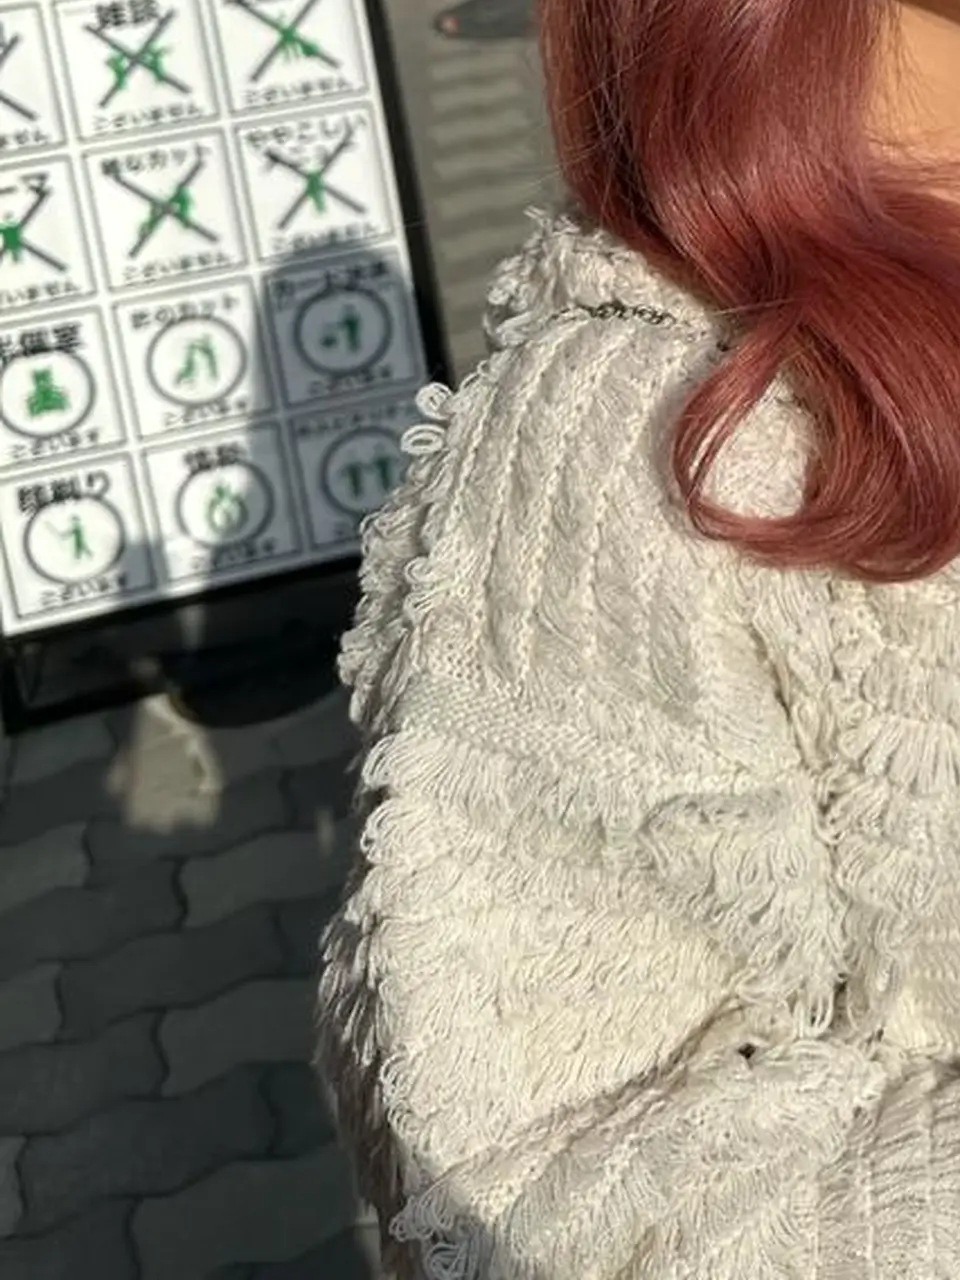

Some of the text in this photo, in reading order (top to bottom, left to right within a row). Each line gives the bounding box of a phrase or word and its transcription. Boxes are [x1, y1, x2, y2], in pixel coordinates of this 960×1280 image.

[245, 75, 353, 107] ございません
[92, 103, 204, 132] ございません
[123, 251, 231, 284] ございません
[163, 399, 248, 428] ございます
[10, 430, 99, 461] ございます
[40, 576, 128, 607] ございます
